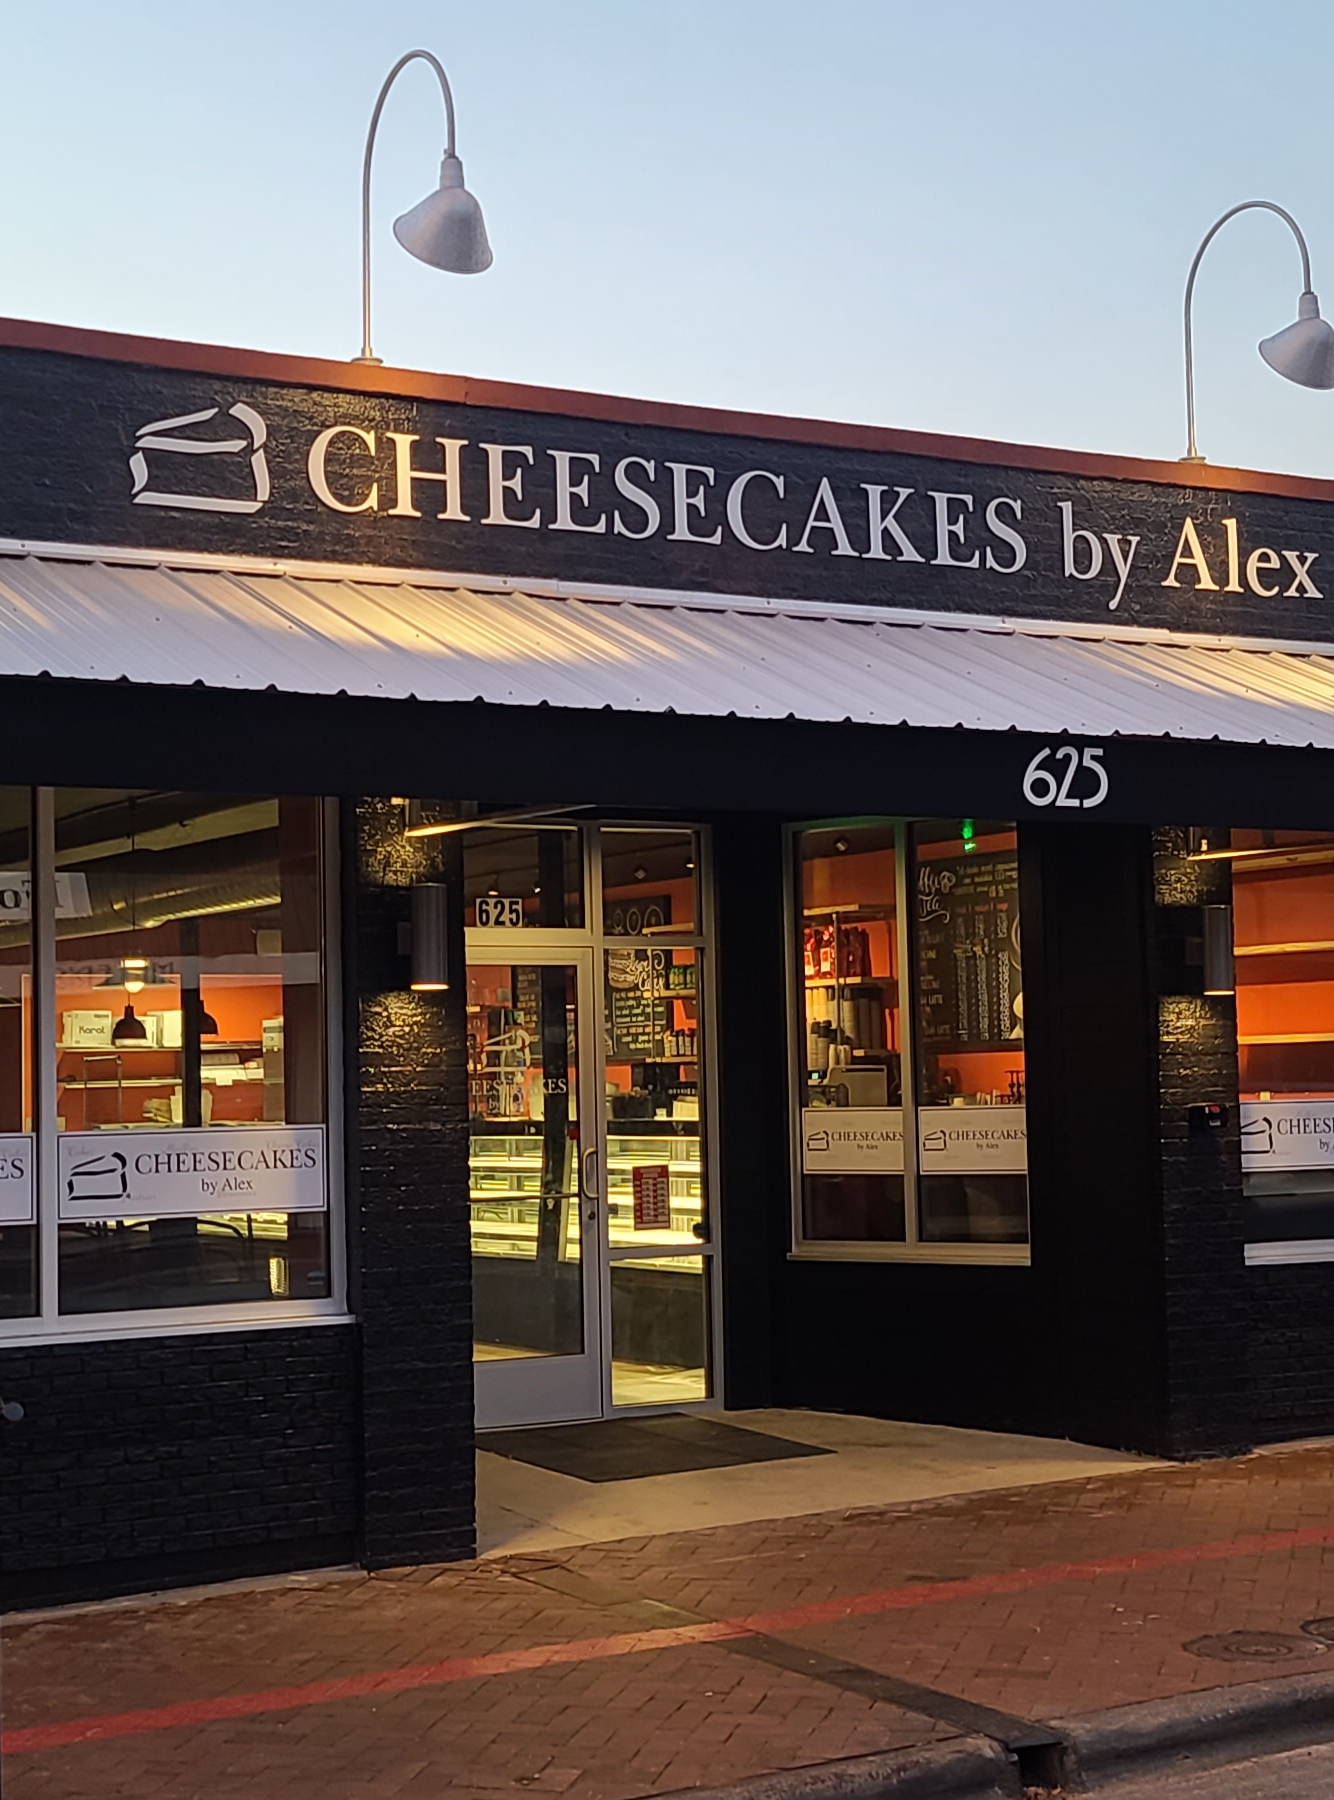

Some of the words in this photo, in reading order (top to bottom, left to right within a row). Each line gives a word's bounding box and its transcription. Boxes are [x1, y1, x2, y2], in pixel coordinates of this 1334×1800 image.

[306, 423, 1028, 576] CHEESECAKES
[1057, 500, 1141, 610] by
[1160, 514, 1324, 600] Alex
[1022, 744, 1110, 808] 625
[478, 899, 521, 927] 625
[831, 1130, 904, 1142] CHEESECAKES
[948, 1129, 1027, 1142] CHEESECAKES
[1319, 1138, 1330, 1153] by
[134, 1147, 317, 1175] CHEESECAKES
[201, 1178, 218, 1195] by
[221, 1176, 254, 1191] Alex
